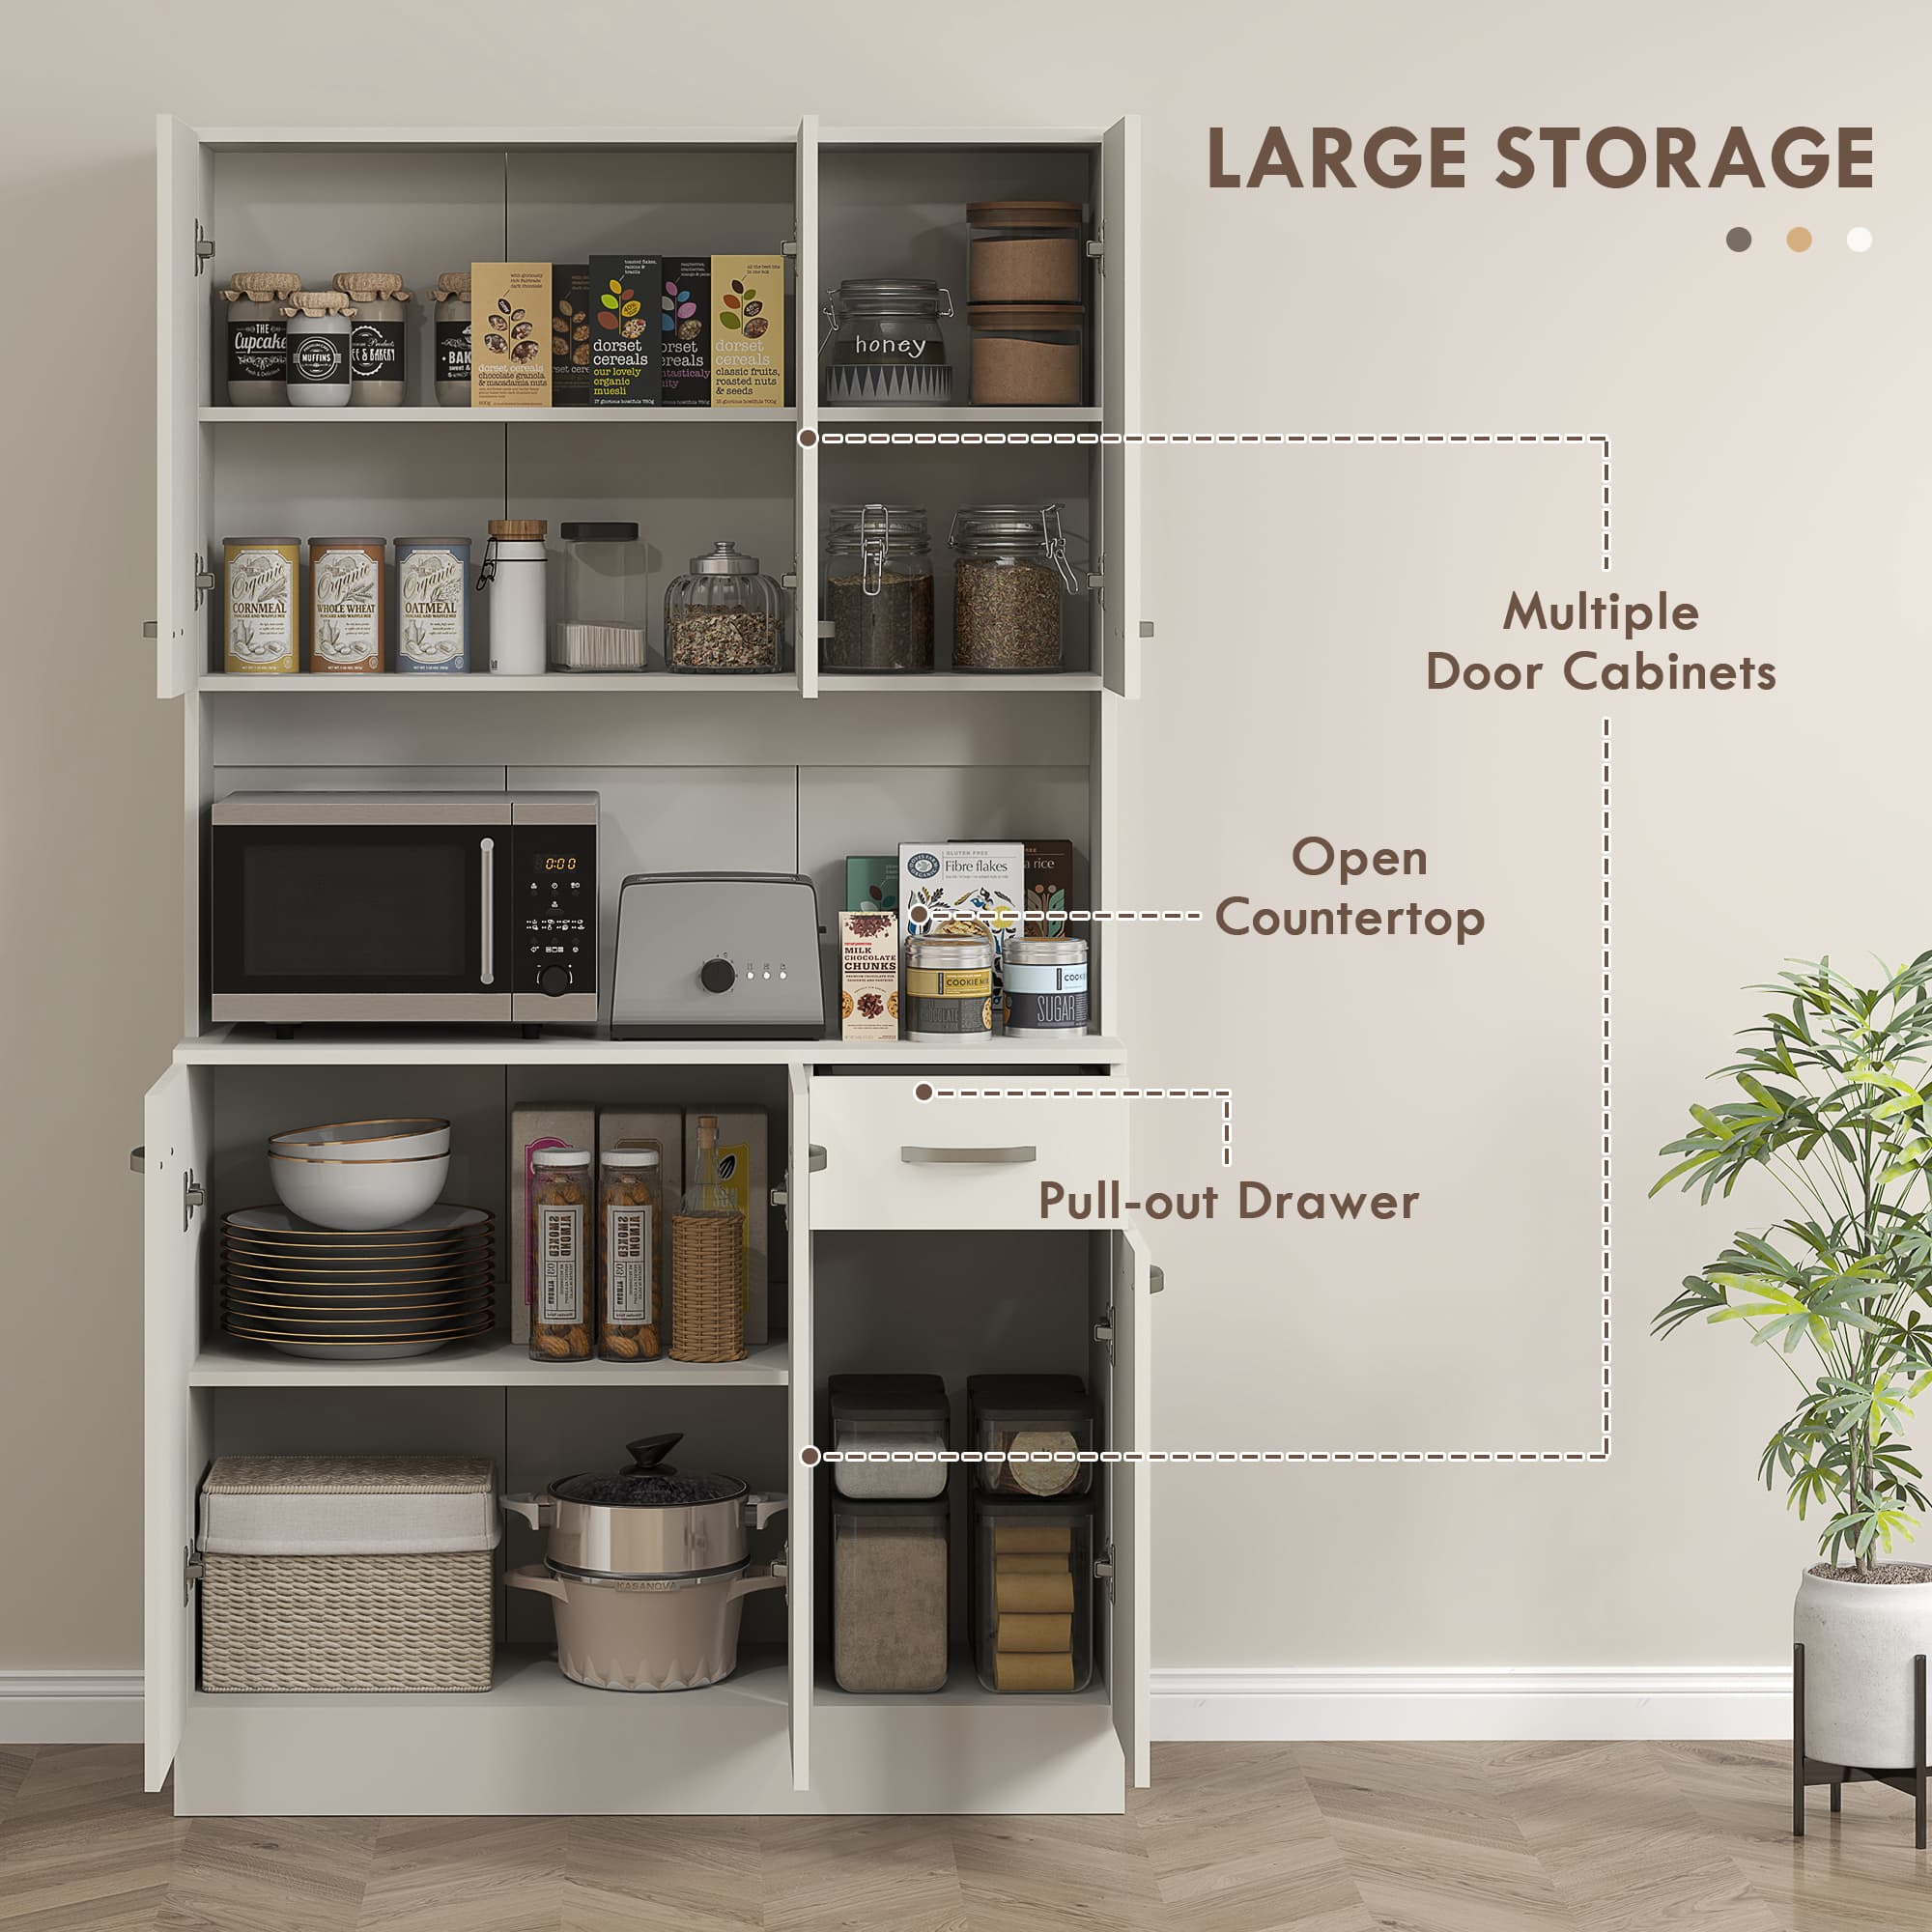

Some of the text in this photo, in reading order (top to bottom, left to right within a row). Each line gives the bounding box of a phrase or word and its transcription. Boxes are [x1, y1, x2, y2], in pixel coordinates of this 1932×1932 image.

[256, 324, 270, 334] THE
[235, 331, 287, 355] Cupcake
[593, 338, 642, 352] dorset
[715, 339, 764, 353] dorset
[856, 334, 926, 358] honey
[302, 354, 331, 362] MUFFINS
[449, 351, 471, 364] BAK
[593, 353, 648, 365] cereals
[715, 353, 770, 366] cereals
[612, 367, 641, 378] lovely
[716, 367, 749, 376] classic
[593, 378, 631, 386] organic
[716, 377, 753, 385] roasted
[593, 386, 626, 395] muesli
[716, 386, 753, 395] & seeds
[232, 602, 287, 613] CORNMEAL
[317, 604, 376, 613] WHOLE WHEAT
[405, 602, 457, 613] OATMEAL
[545, 858, 577, 869] 0:00
[946, 859, 1009, 872] Fibre flakes
[1034, 857, 1055, 869] rice
[844, 961, 896, 971] CHUNKS
[1037, 995, 1075, 1022] SUGAR
